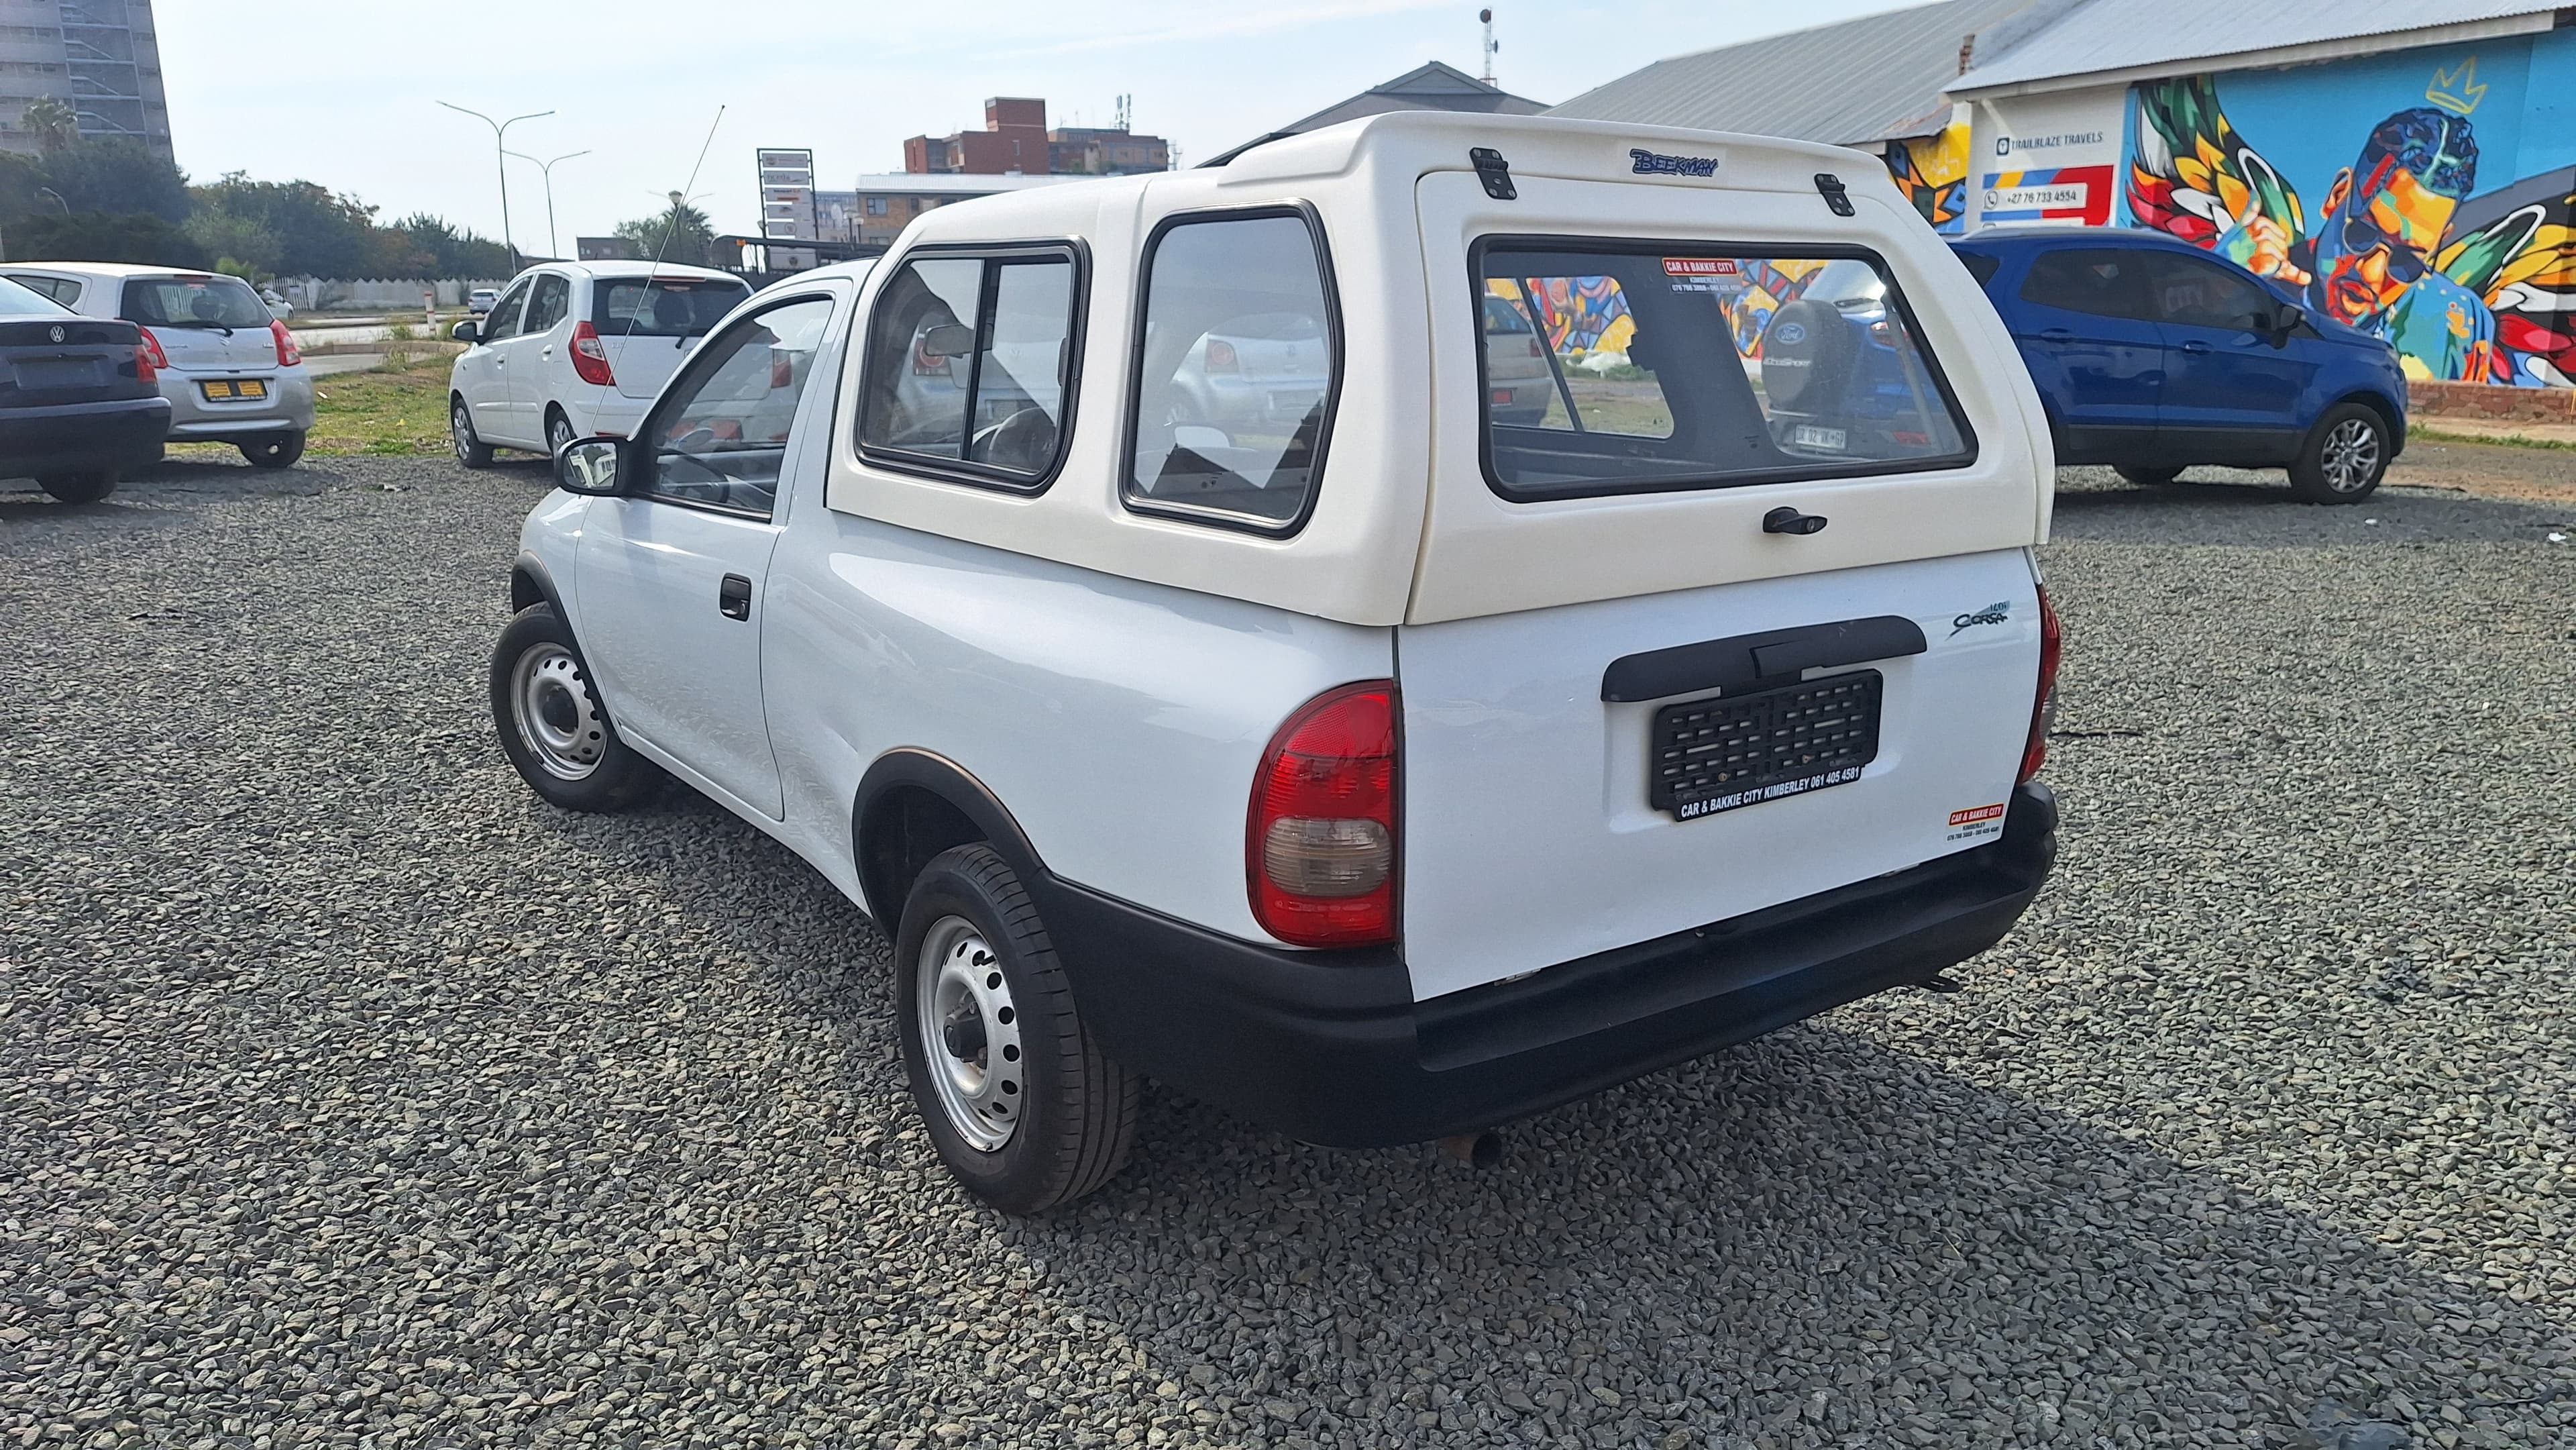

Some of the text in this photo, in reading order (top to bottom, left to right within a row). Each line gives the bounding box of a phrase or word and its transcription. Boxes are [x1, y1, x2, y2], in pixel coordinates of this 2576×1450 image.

[2011, 136, 2061, 150] TRAILBLAZE
[2064, 131, 2103, 144] TRAVELS
[1629, 148, 1719, 177] BEEKMAN
[2007, 189, 2076, 203] +27 76 733 4554
[1666, 261, 1733, 272] CAR & BAKKIE CITY
[1681, 766, 1860, 818] CAR & BAKKIE CITY KIMBERLEY 061 405 4581
[1951, 806, 2002, 823] CAR & BAKKIE CITY
